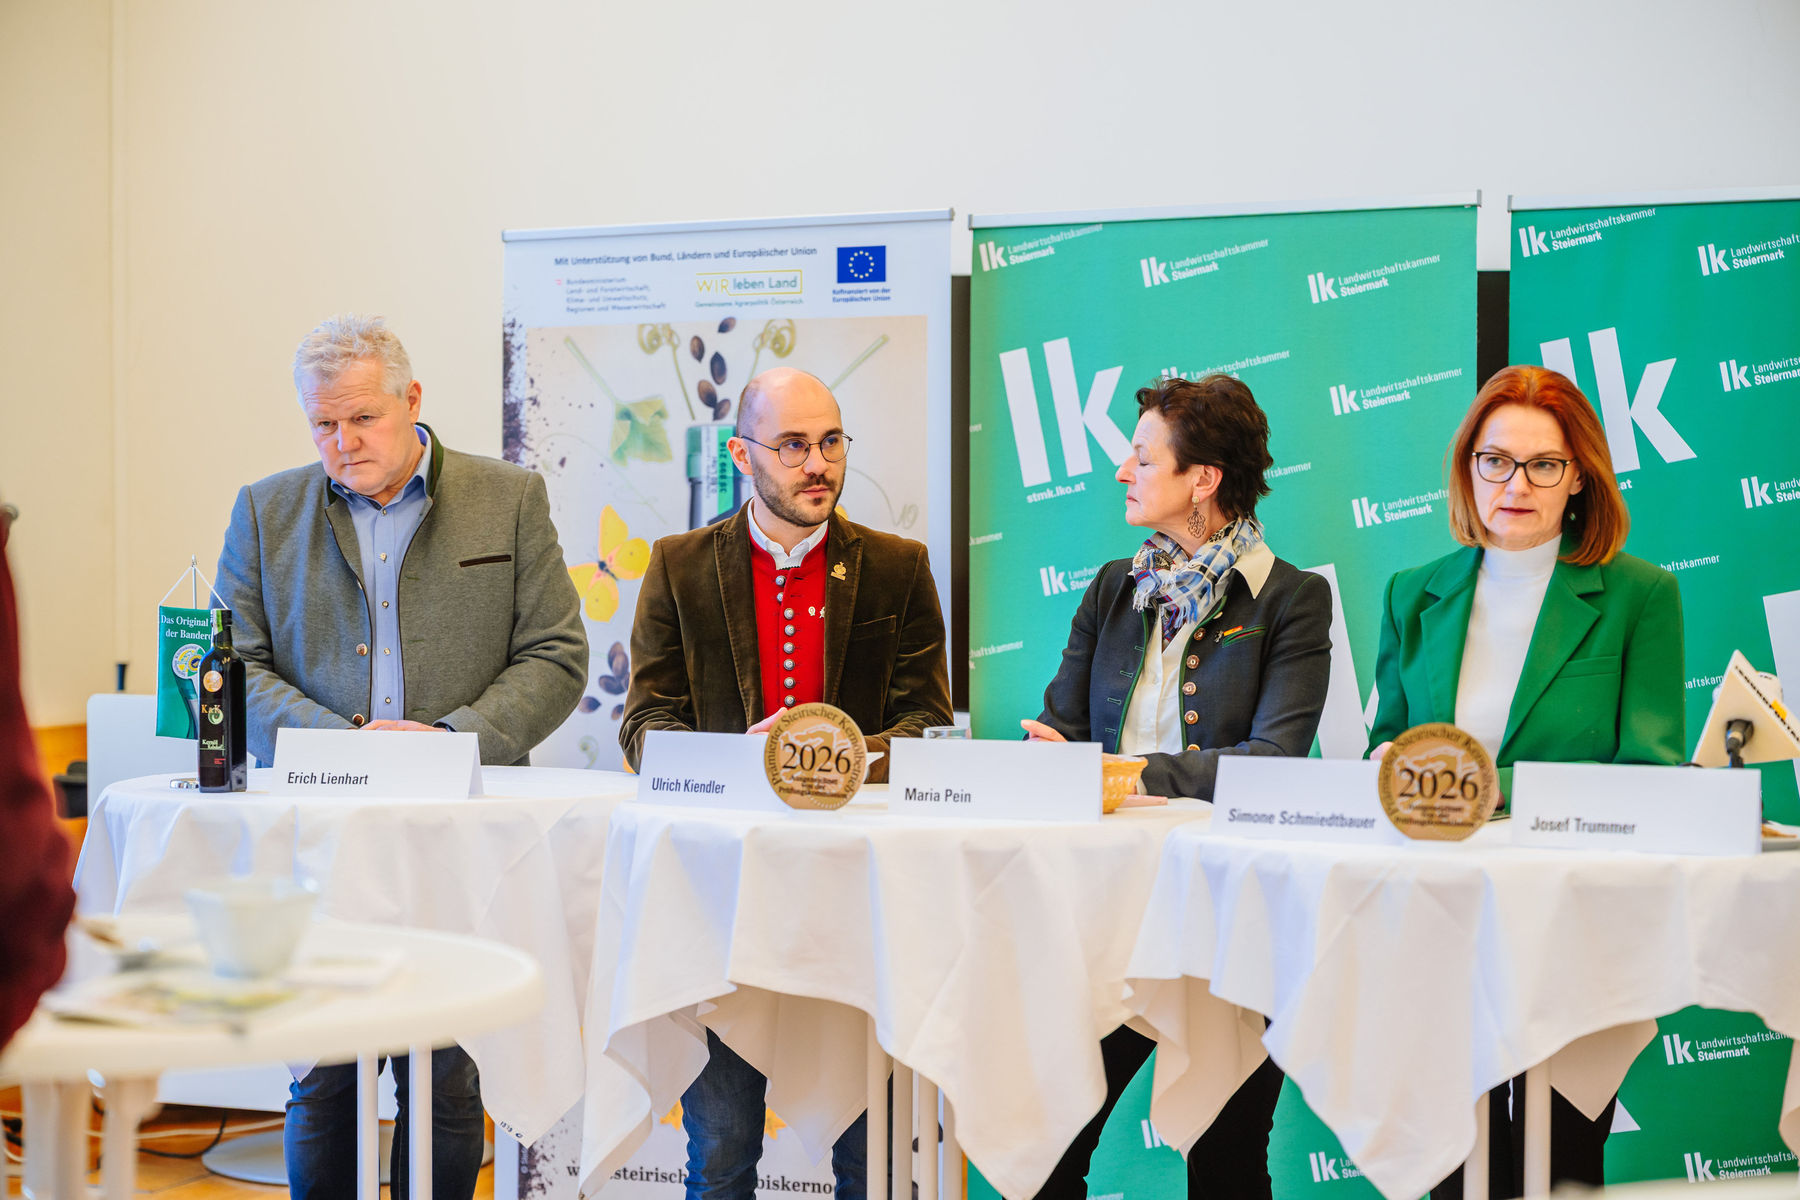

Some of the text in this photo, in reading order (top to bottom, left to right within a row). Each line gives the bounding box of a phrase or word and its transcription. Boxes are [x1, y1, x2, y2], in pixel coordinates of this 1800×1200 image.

[1549, 207, 1657, 240] Landwirtschaftskammer
[1007, 223, 1103, 254] Landwirtschaftskammer
[1519, 225, 1550, 258] lk
[1552, 230, 1602, 251] Steiermark
[1730, 233, 1800, 258] Landwirtschaft
[554, 256, 569, 265] Mit
[571, 255, 630, 266] Unterstützung
[650, 252, 675, 261] Bund,
[676, 250, 712, 261] Ländern
[714, 250, 730, 259] und
[732, 247, 788, 259] Europäischer
[790, 247, 817, 256] Union
[979, 241, 1008, 272] lk
[1008, 245, 1056, 265] Steiermark
[1169, 239, 1269, 270] Landwirtschaftskammer
[1697, 243, 1731, 276] lk
[1732, 248, 1785, 269] Steiermark
[1140, 256, 1170, 288] lk
[1171, 261, 1219, 281] Steiermark
[1338, 254, 1441, 286] Landwirtschaftskammer
[696, 276, 798, 295] WIR leben Land
[1307, 272, 1339, 304] lk
[1340, 276, 1389, 297] Steiermark
[1360, 367, 1463, 398] Landwirtschaftskammer
[1719, 359, 1752, 392] lk
[1329, 384, 1360, 416] lk
[1362, 390, 1411, 410] Steiermark
[999, 337, 1134, 488] lk
[1026, 481, 1086, 503] stmk.lko.at
[1382, 488, 1449, 512] Landwirtschafts
[1741, 476, 1774, 509] lk
[1776, 489, 1800, 503] Steie
[1351, 497, 1382, 529] lk
[1384, 503, 1433, 523] Steiermark
[1660, 555, 1720, 572] haftskammer
[1040, 565, 1068, 597] lk
[161, 614, 209, 628] Das Original
[165, 629, 179, 638] der
[781, 706, 838, 727] Steirischer
[782, 743, 851, 775] 2026
[287, 771, 369, 786] Erich Lienhart
[651, 777, 726, 794] Ulrich Kiendler
[1399, 768, 1479, 801] 2026
[905, 787, 972, 803] Maria Pein
[1228, 808, 1276, 825] Simone
[1279, 810, 1376, 829] Schmiedtbauer
[1530, 816, 1637, 834] Josef Trummer
[1663, 1033, 1695, 1066] lk
[1698, 1045, 1750, 1062] Steiermark
[1309, 1151, 1340, 1183] lk
[1684, 1152, 1716, 1184] lk
[1717, 1150, 1798, 1169] Landwirtschaftsk
[1719, 1165, 1772, 1181] Steiermark
